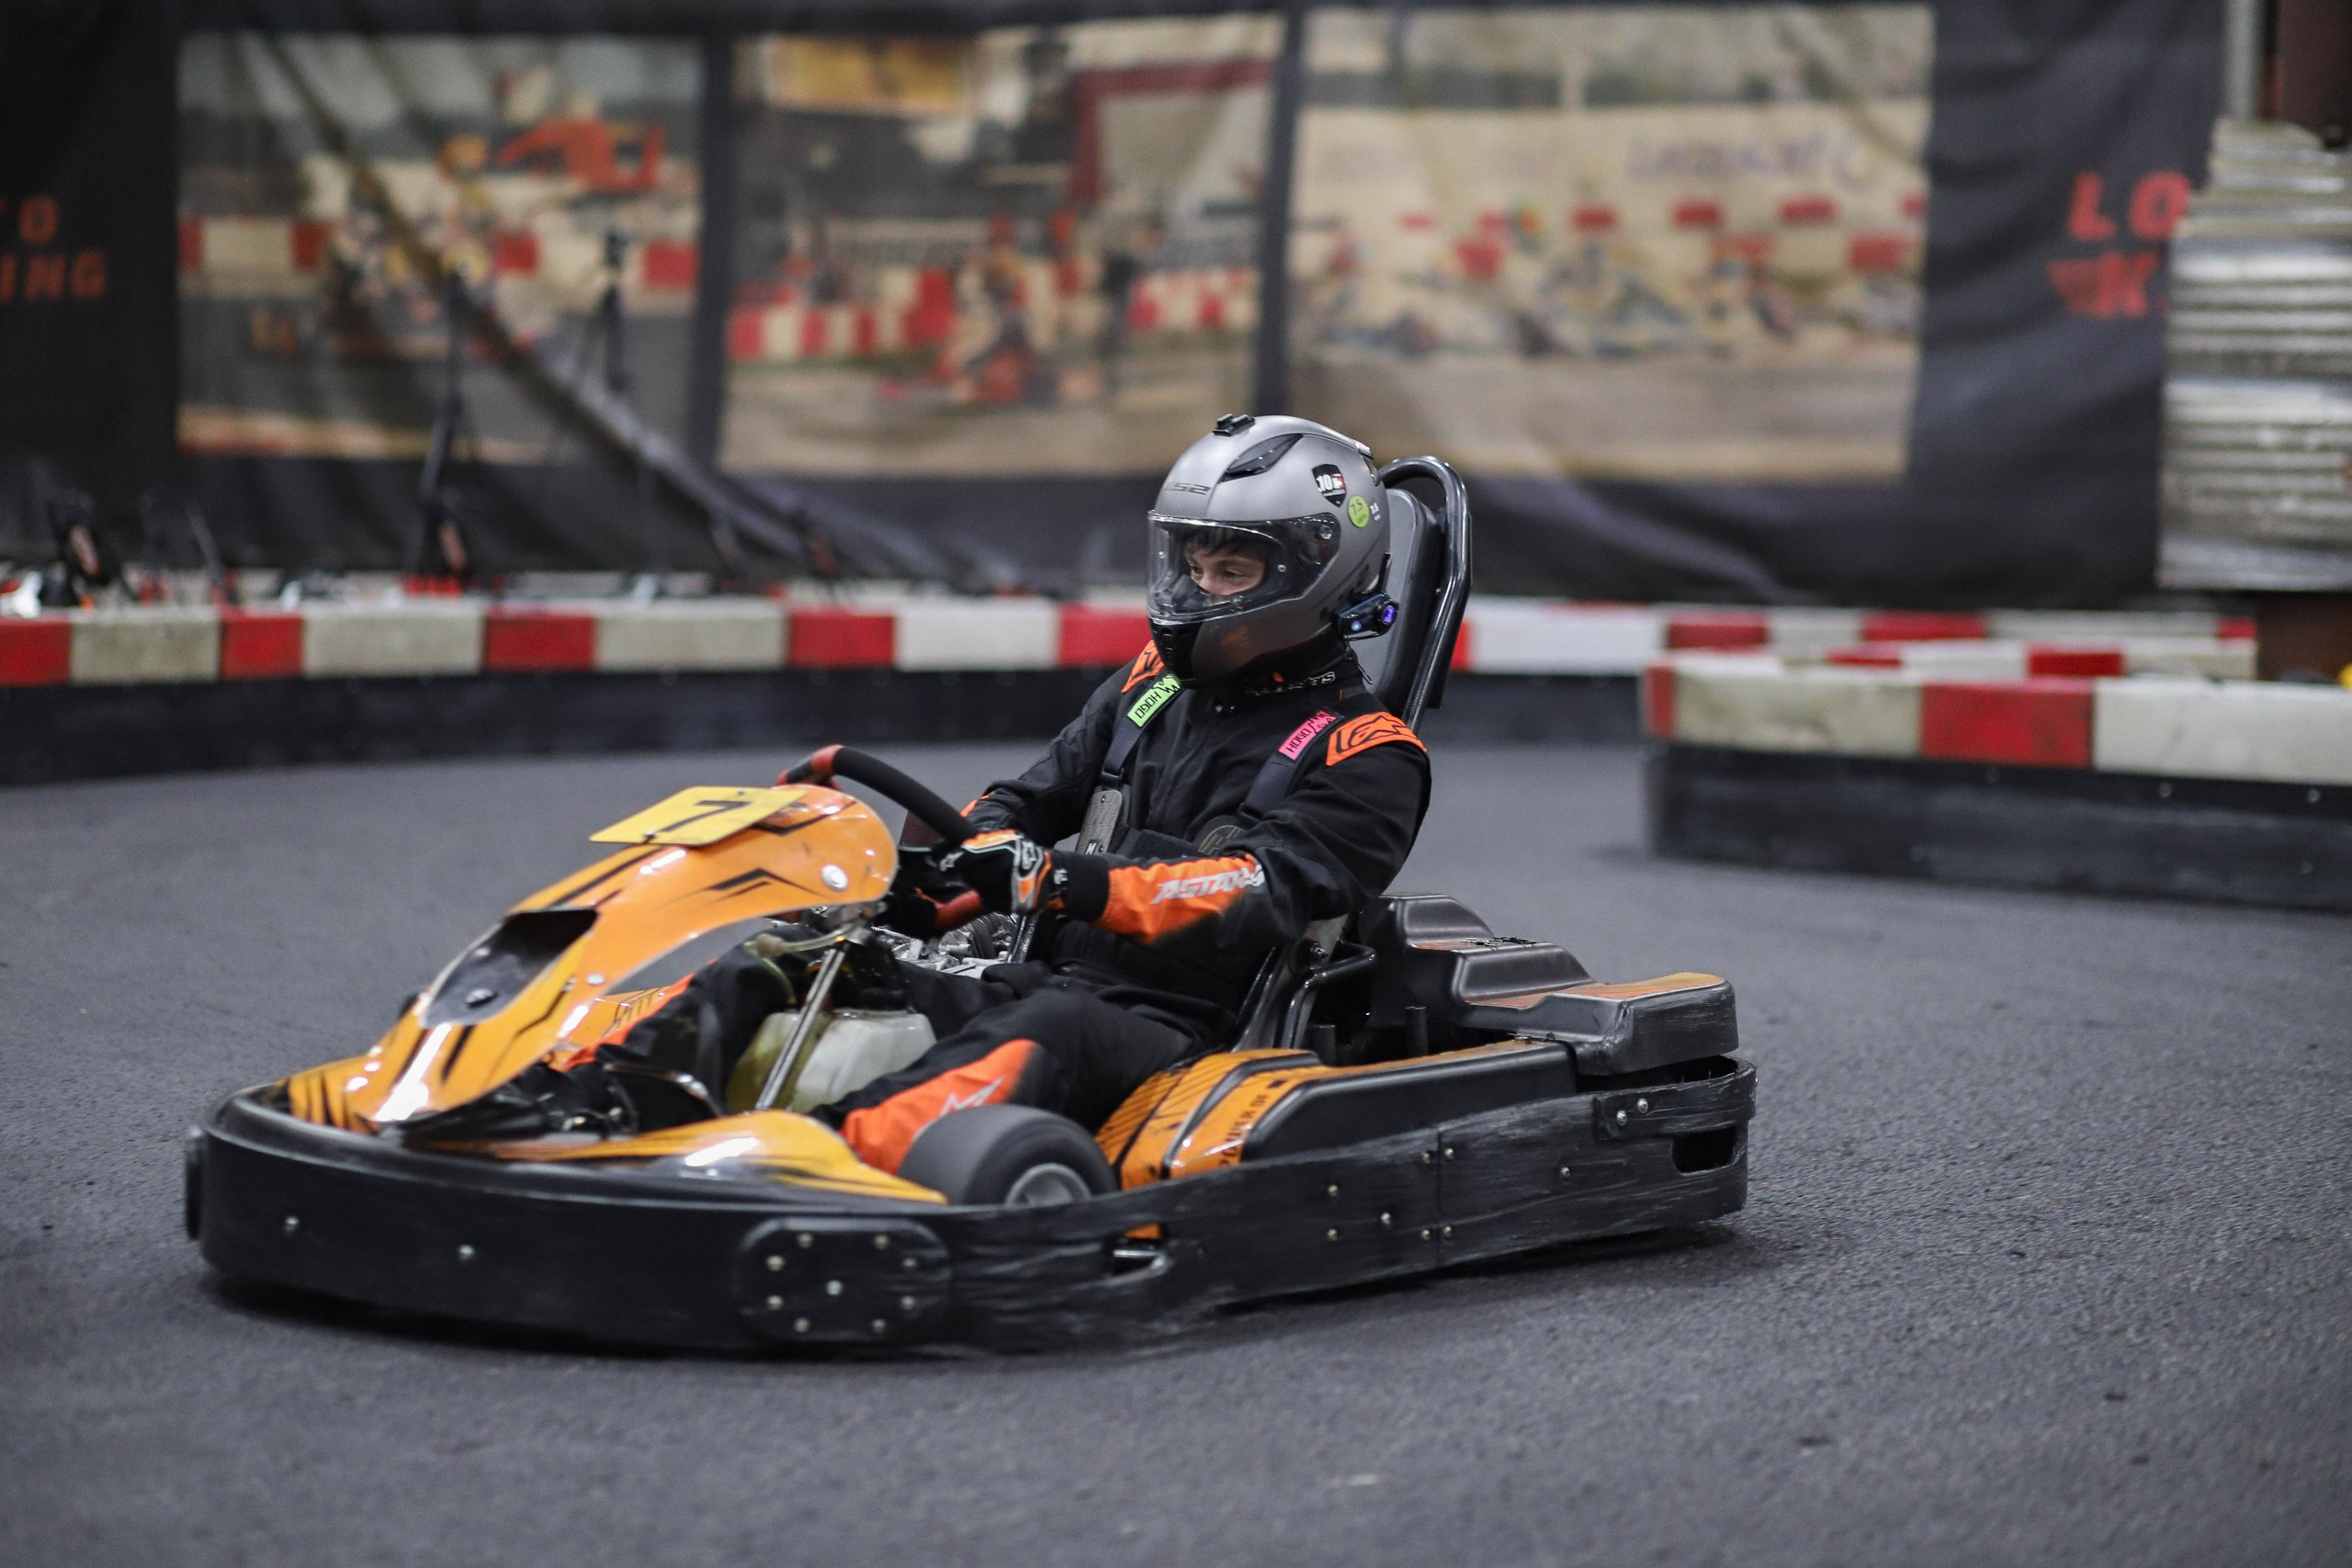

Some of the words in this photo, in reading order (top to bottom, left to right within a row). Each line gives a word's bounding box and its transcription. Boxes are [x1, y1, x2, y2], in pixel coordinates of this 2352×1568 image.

[0, 196, 60, 245] O
[2067, 168, 2190, 242] LO
[1135, 691, 1162, 719] HOGO
[1285, 728, 1312, 753] HOGO
[659, 800, 752, 831] 7
